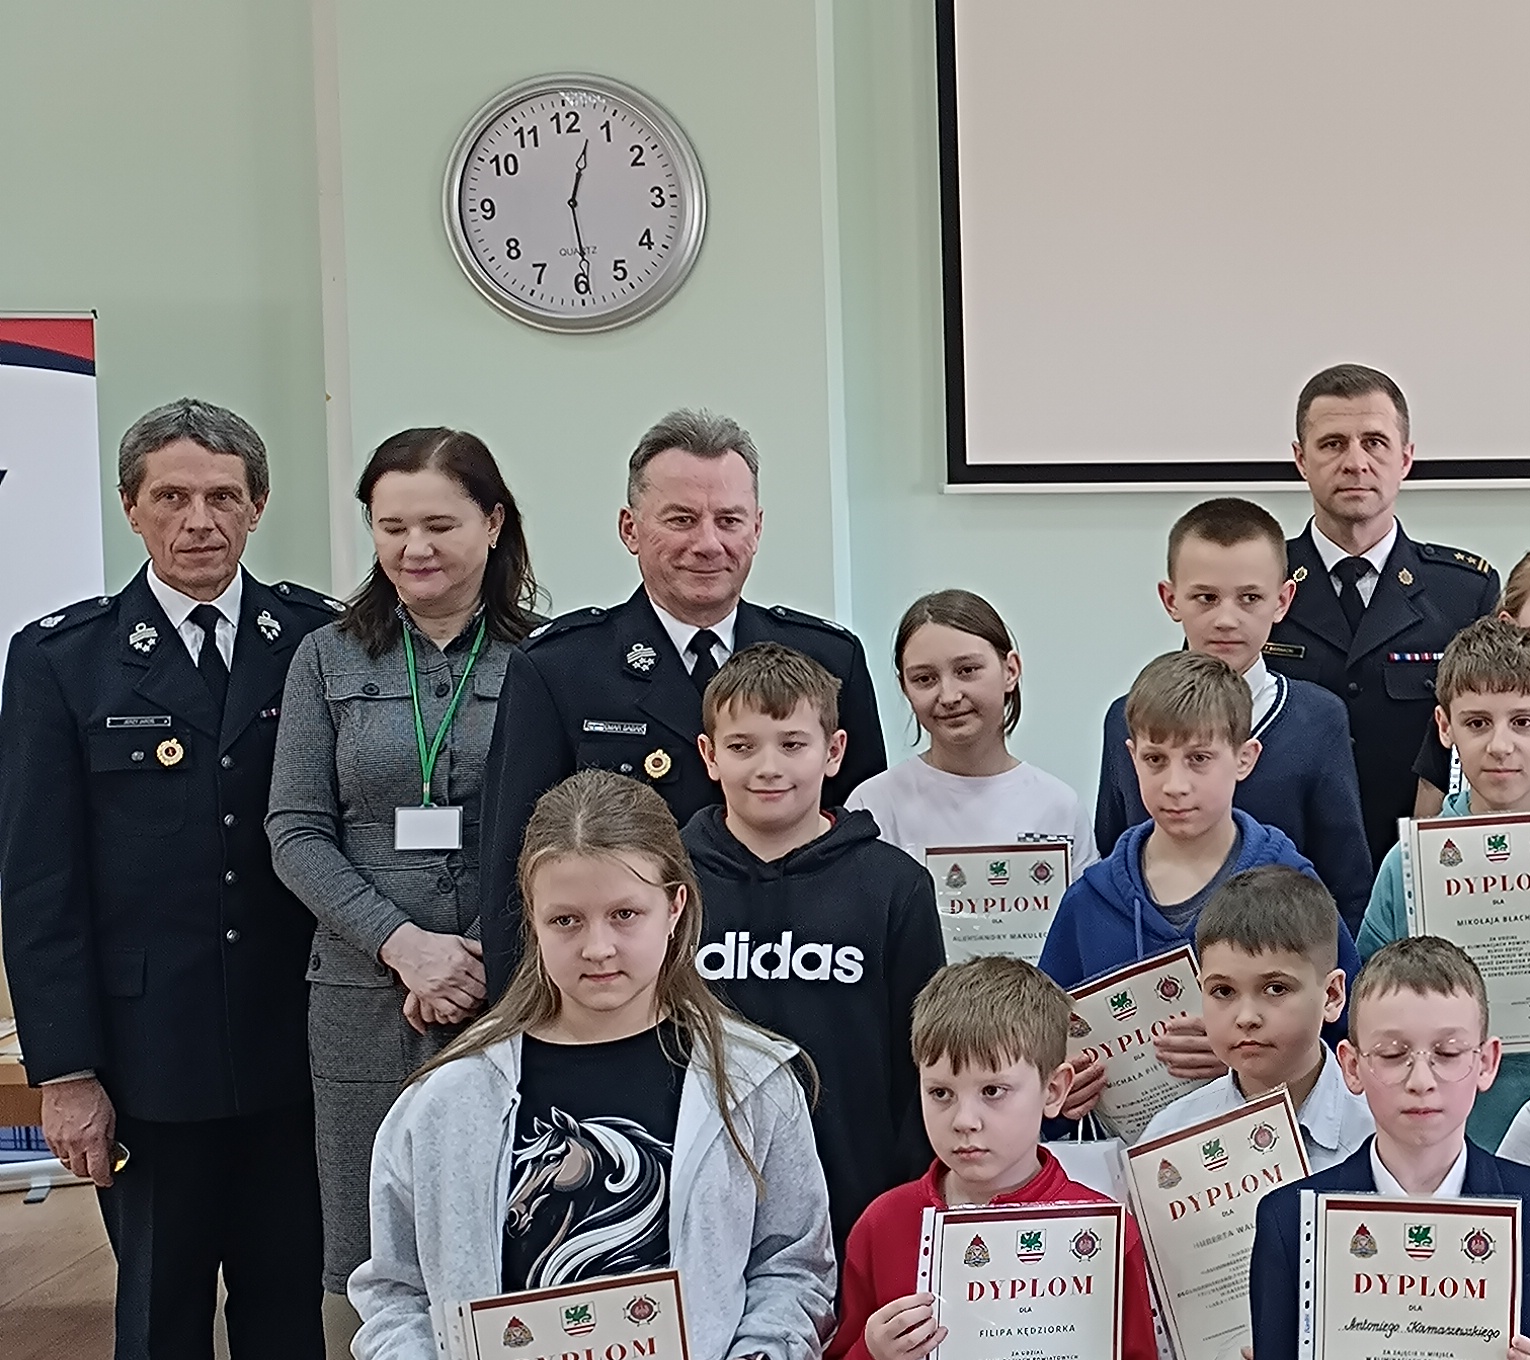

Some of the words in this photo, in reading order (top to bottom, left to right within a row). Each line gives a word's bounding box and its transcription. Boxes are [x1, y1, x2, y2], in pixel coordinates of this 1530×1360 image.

[550, 111, 581, 134] 12
[600, 120, 612, 142] 1
[514, 126, 539, 148] 11
[490, 153, 518, 176] 10
[629, 145, 645, 166] 2
[650, 186, 666, 208] 3
[480, 198, 495, 220] 9
[505, 238, 521, 260] 8
[638, 228, 654, 250] 4
[532, 263, 547, 284] 7
[612, 259, 628, 281] 5
[574, 273, 590, 294] 6
[950, 895, 1050, 914] DYPLOM
[1457, 917, 1500, 926] MIKOŁAJA
[695, 930, 864, 983] adidas
[1081, 1011, 1187, 1064] DYPLO
[1169, 1163, 1283, 1221] DYPLOM
[966, 1274, 1093, 1301] DYPLOM
[1354, 1272, 1487, 1299] DYPLOM
[979, 1328, 1012, 1337] FILIPA
[1017, 1324, 1075, 1337] KĘDZIORKA
[1344, 1316, 1400, 1338] Antoniego
